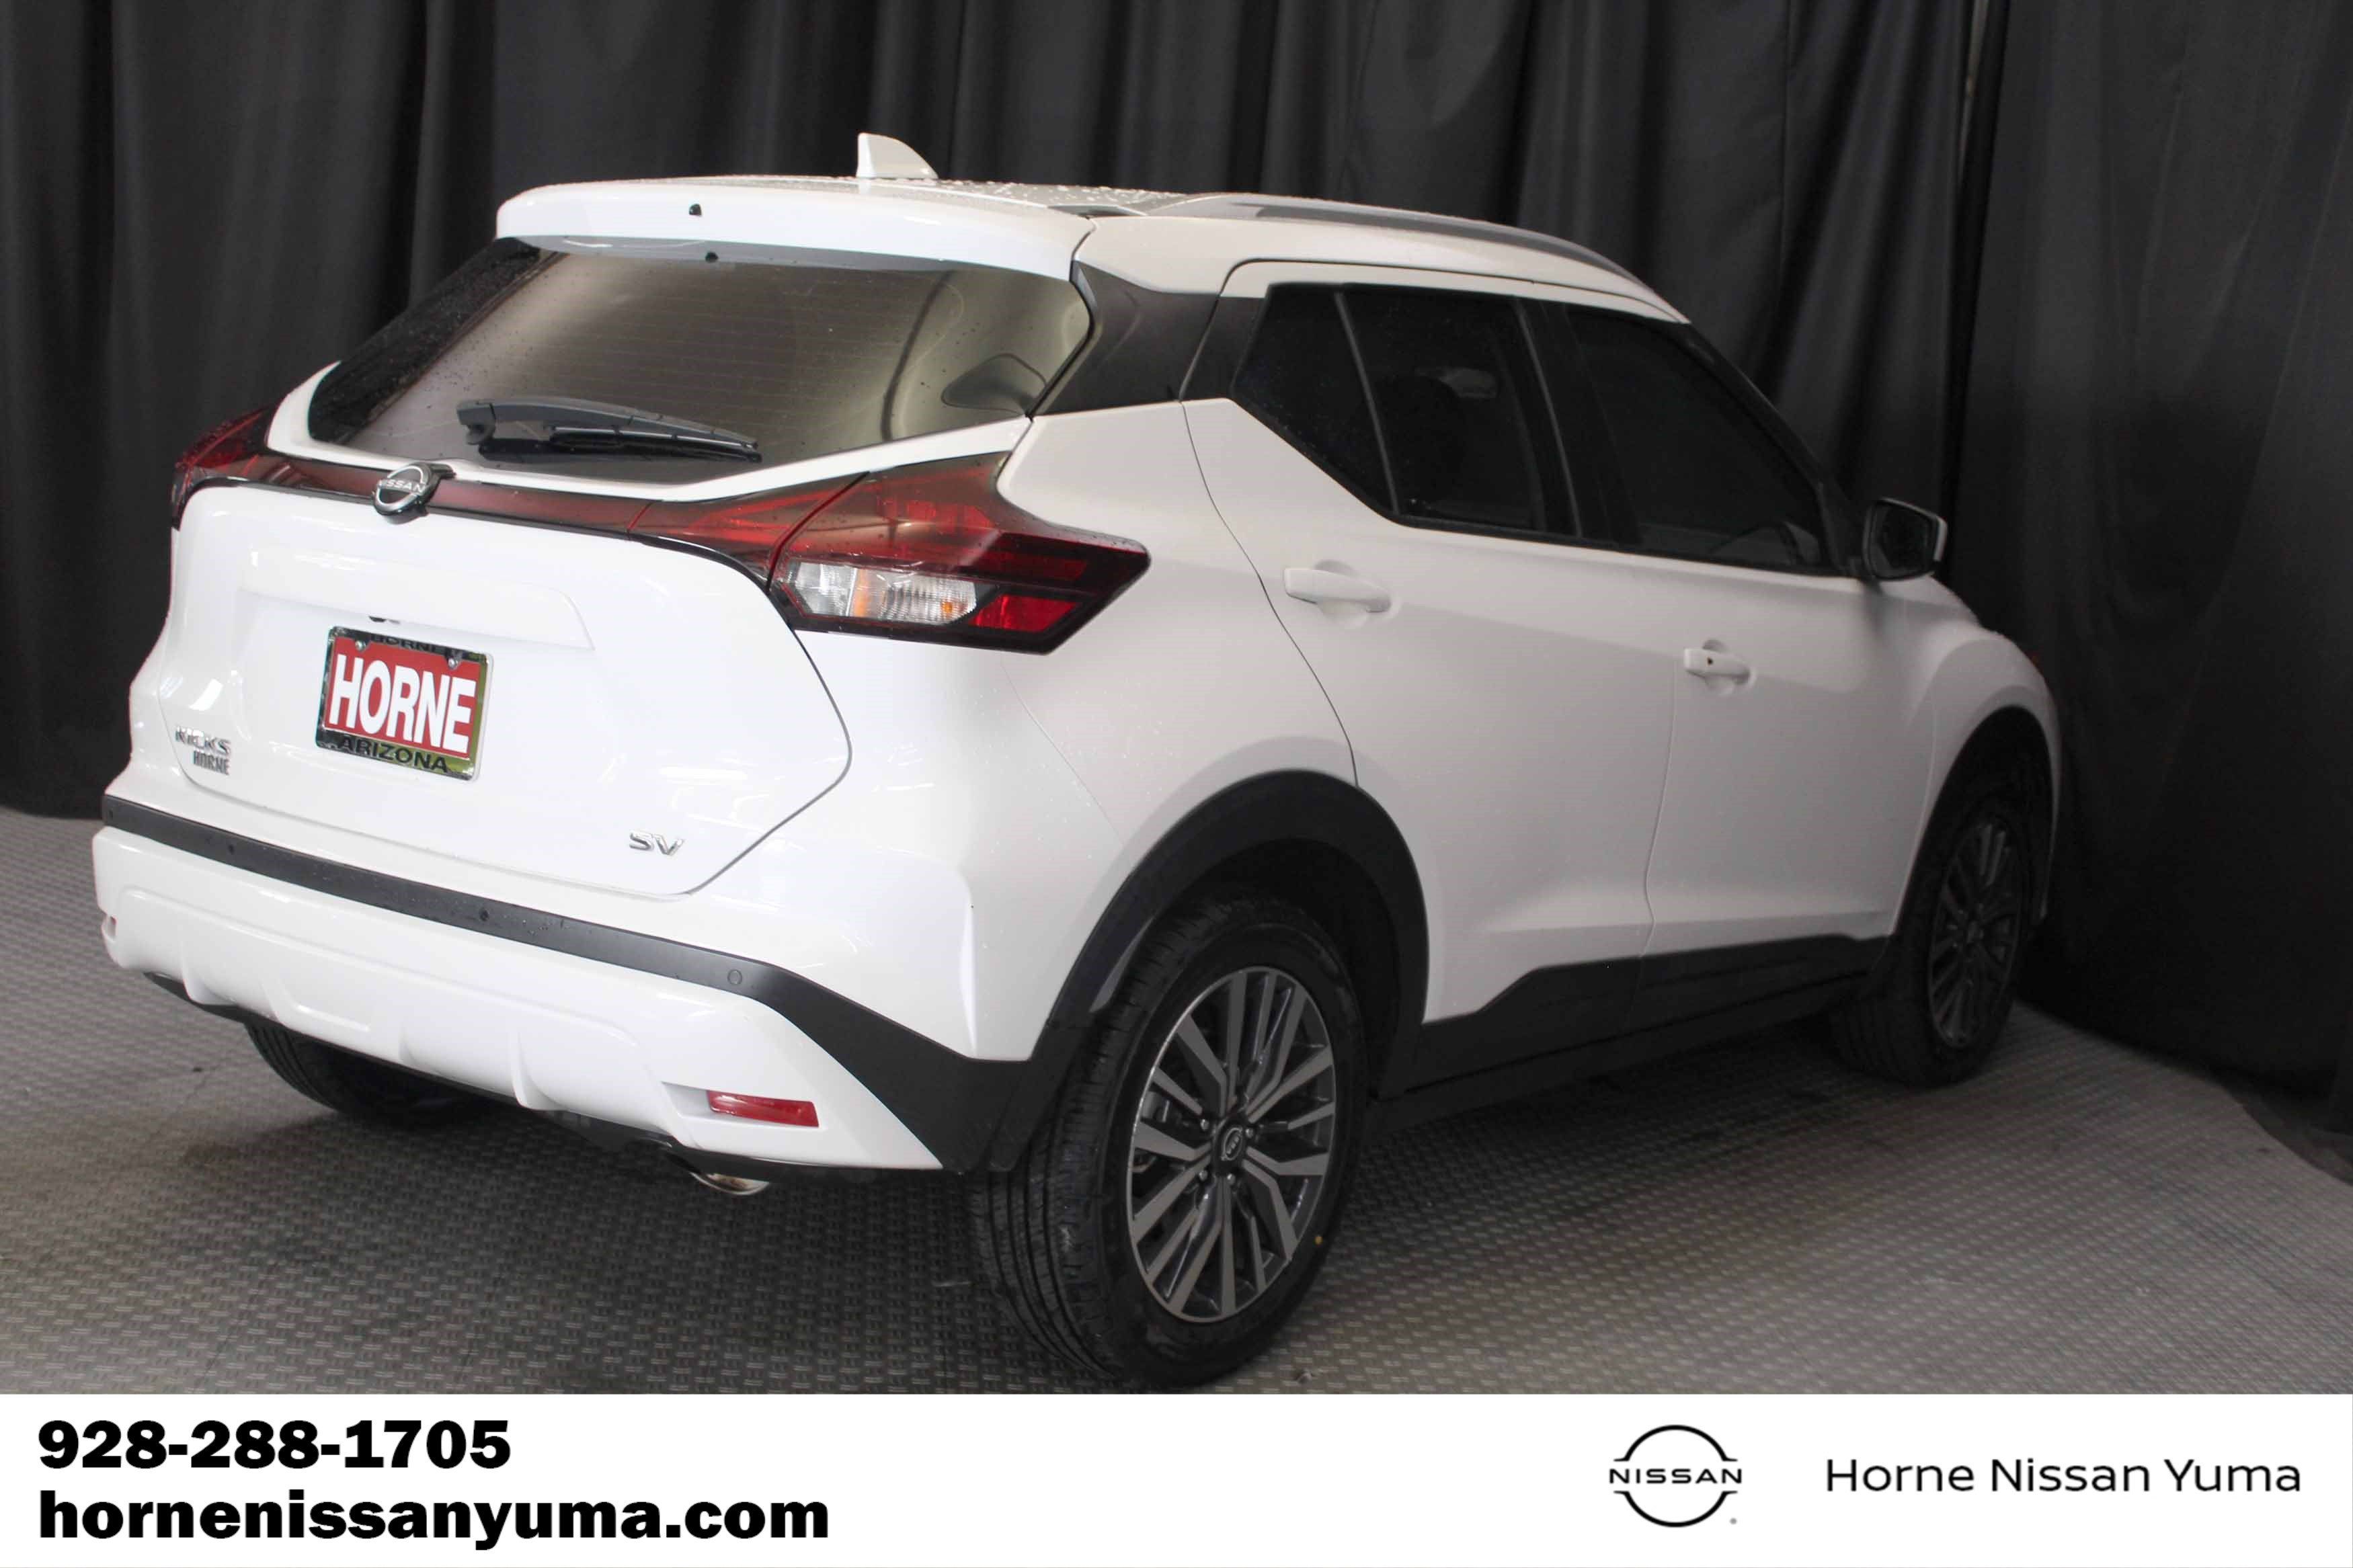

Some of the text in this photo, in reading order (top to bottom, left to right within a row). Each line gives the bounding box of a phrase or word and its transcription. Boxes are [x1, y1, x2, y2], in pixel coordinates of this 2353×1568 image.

[329, 653, 476, 753] HORNE
[337, 737, 449, 773] ARIZONA
[629, 829, 684, 856] SV
